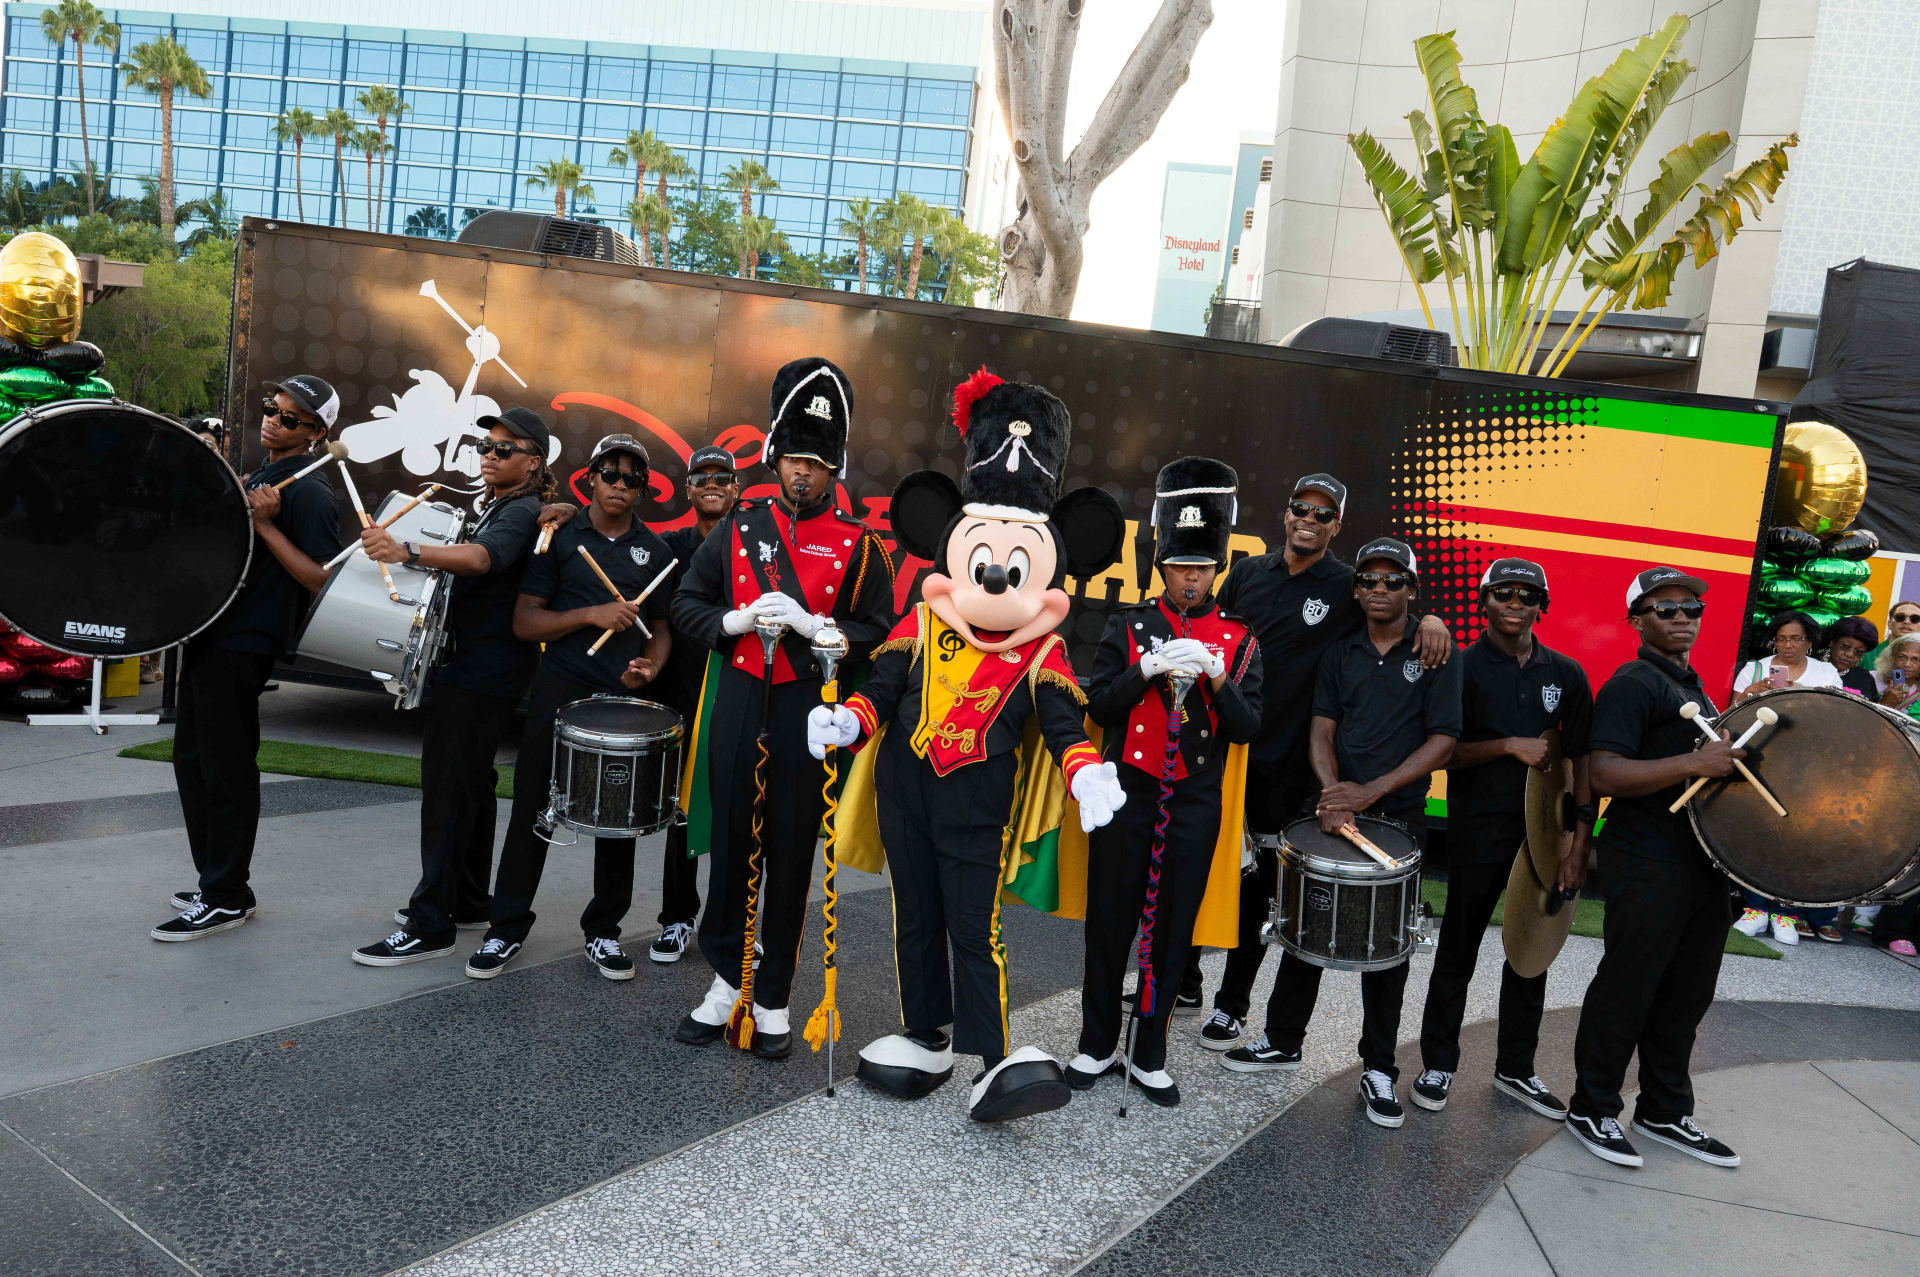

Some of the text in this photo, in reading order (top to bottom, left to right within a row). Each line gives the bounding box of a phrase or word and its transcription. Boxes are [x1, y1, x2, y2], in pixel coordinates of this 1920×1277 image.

[1163, 235, 1220, 253] Disneyland
[1178, 256, 1204, 271] Hotel
[806, 543, 832, 553] JARED
[1306, 604, 1326, 617] BU
[64, 621, 126, 639] EVANS
[1406, 663, 1422, 674] BU
[1545, 691, 1562, 703] BU
